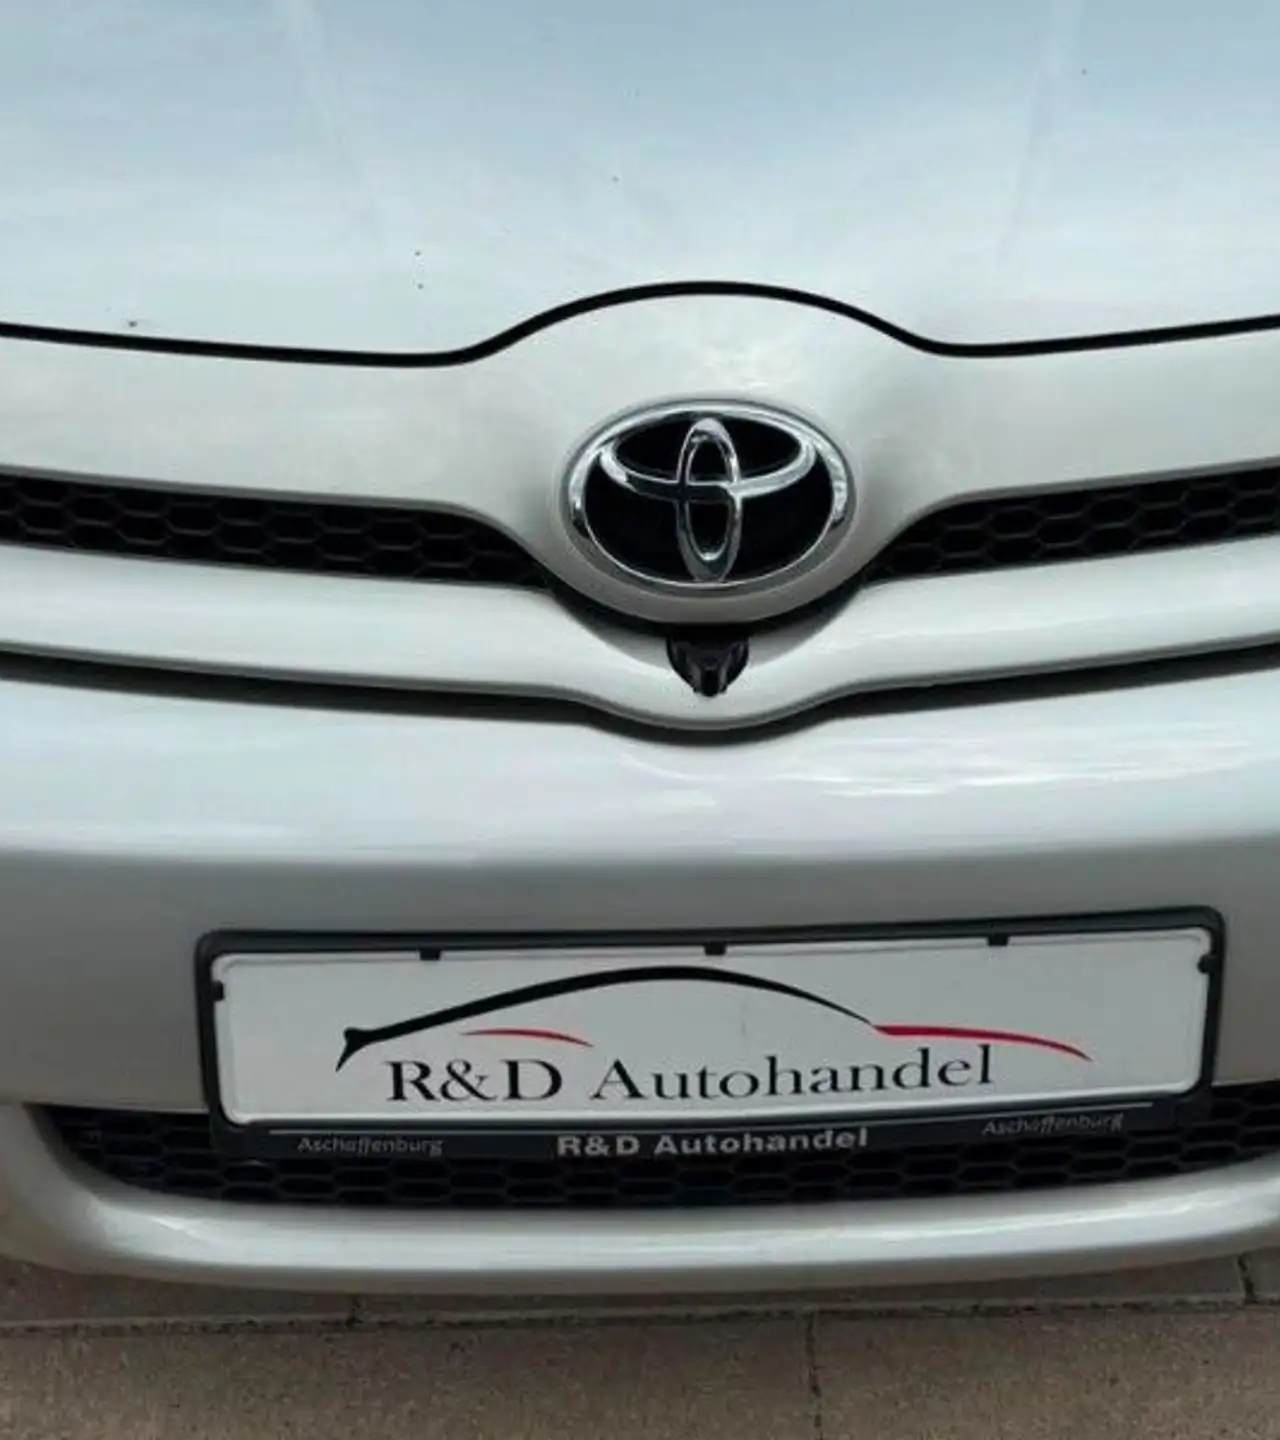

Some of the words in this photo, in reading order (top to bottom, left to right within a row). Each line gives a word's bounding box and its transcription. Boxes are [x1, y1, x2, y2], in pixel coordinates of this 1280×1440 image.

[386, 1060, 562, 1102] R&D
[591, 1044, 994, 1101] Autohandel
[982, 1113, 1125, 1136] Aschaffenburg
[297, 1133, 444, 1157] Aschaffenburg
[557, 1135, 640, 1157] R&D
[654, 1127, 867, 1155] Autohandel
